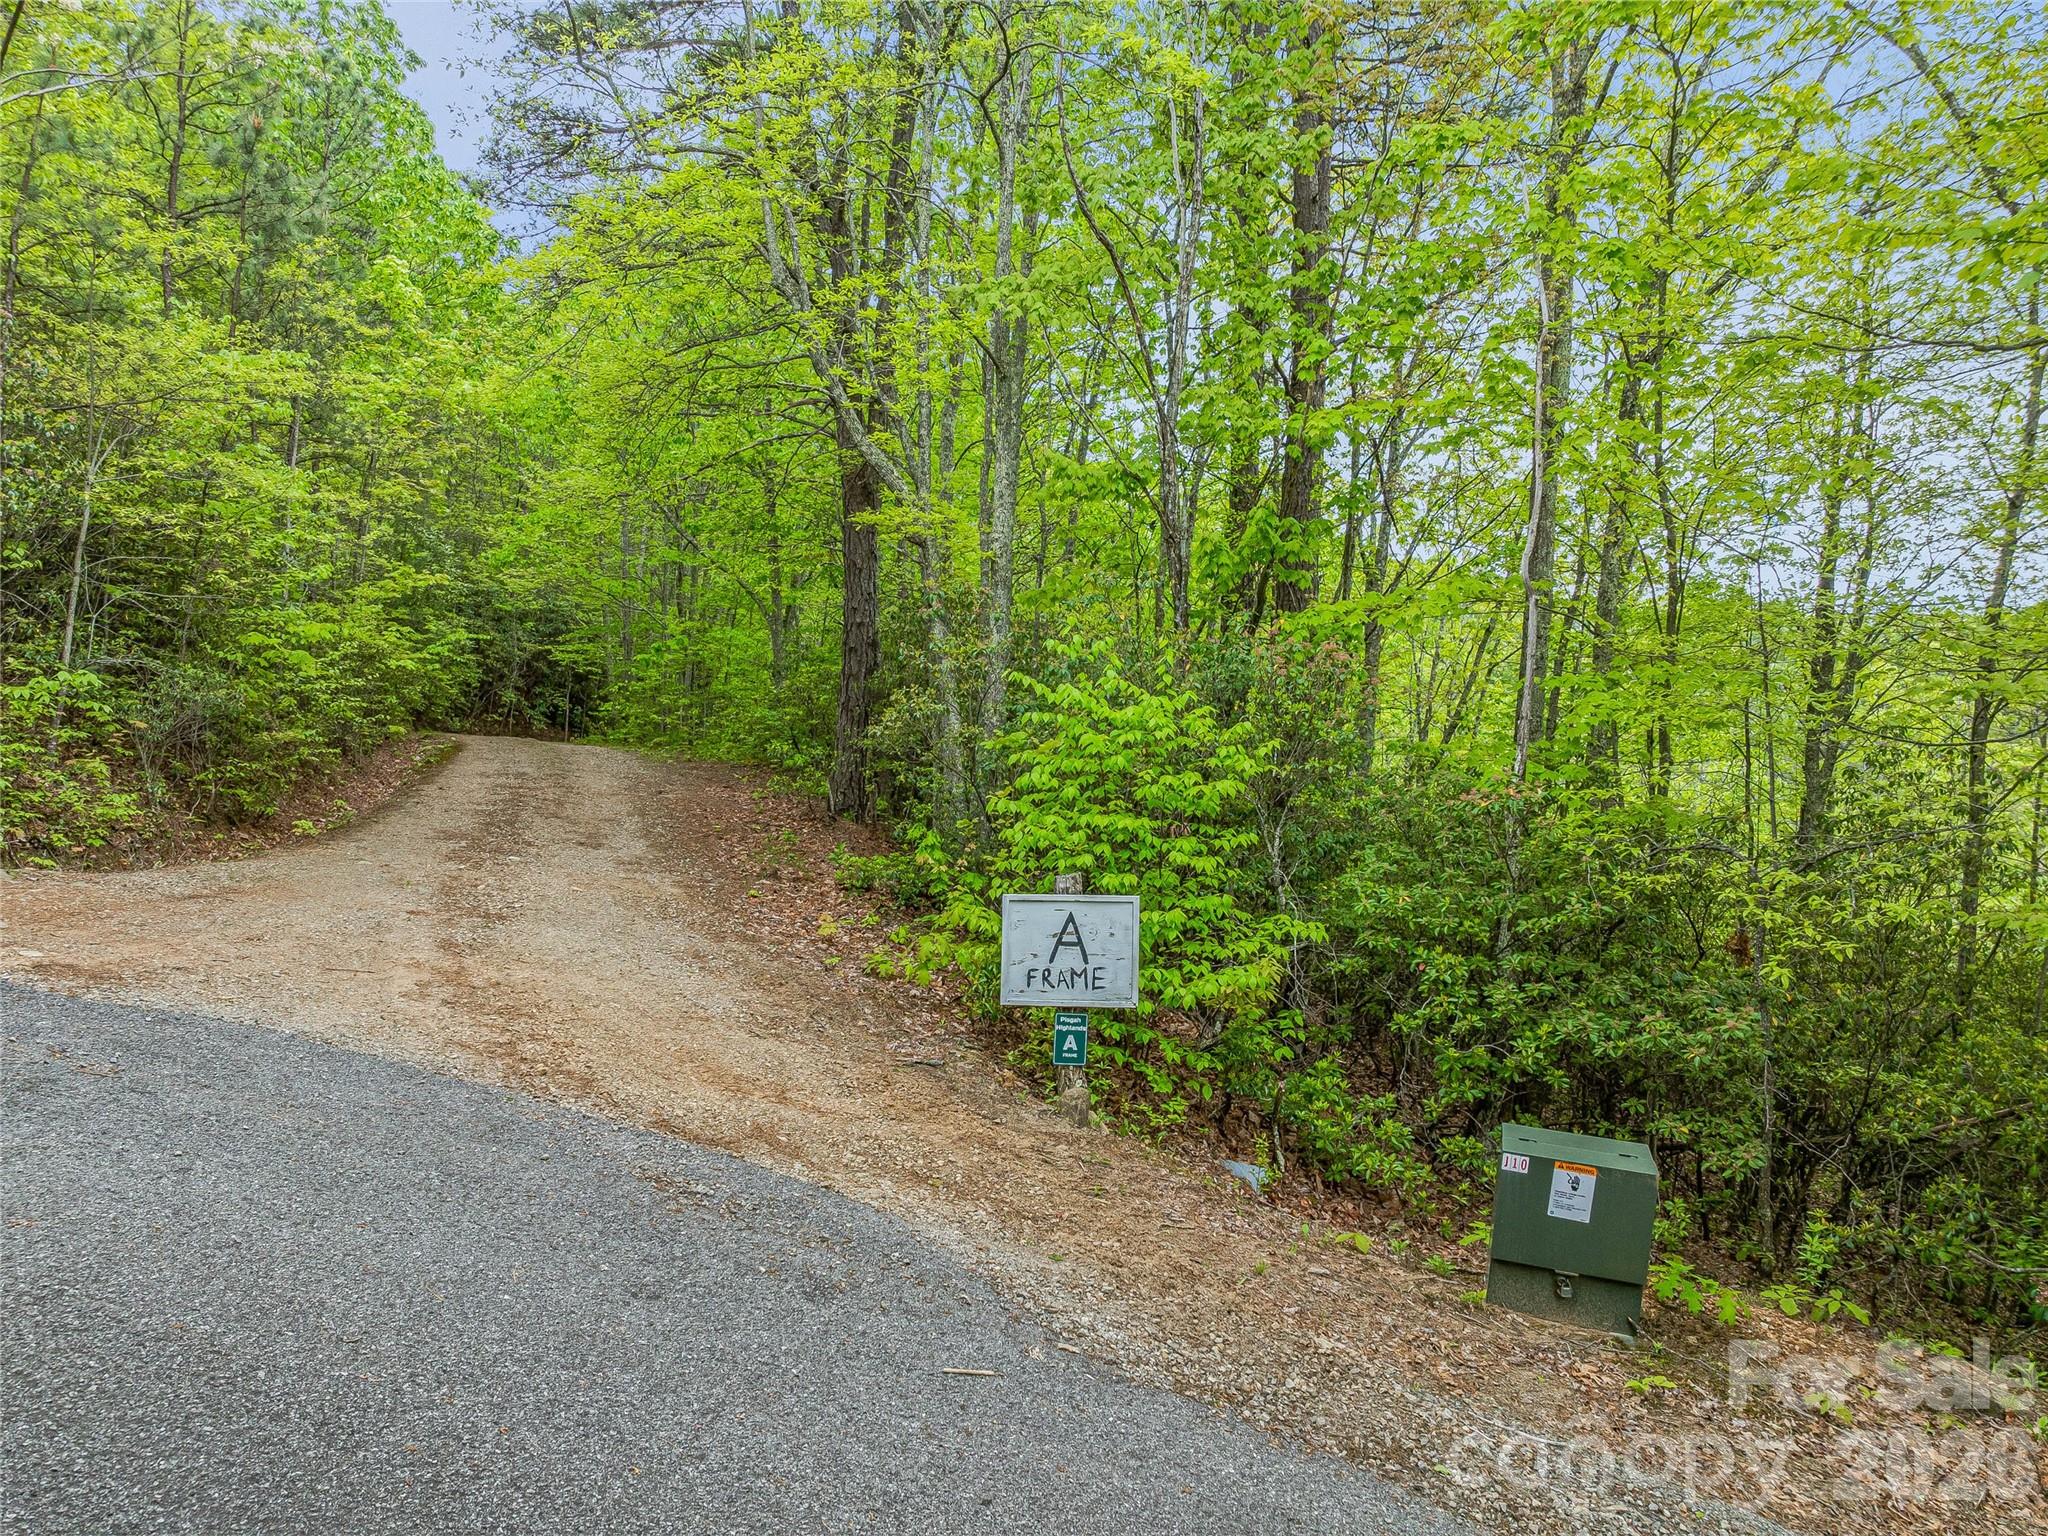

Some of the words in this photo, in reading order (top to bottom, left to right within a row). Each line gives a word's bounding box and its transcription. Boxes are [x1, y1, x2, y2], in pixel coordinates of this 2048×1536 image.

[1048, 911, 1089, 965] A
[1026, 966, 1107, 991] FRAME
[1060, 1016, 1082, 1024] Pisgah
[1062, 1034, 1078, 1051] A
[1565, 1165, 1595, 1176] WARNING
